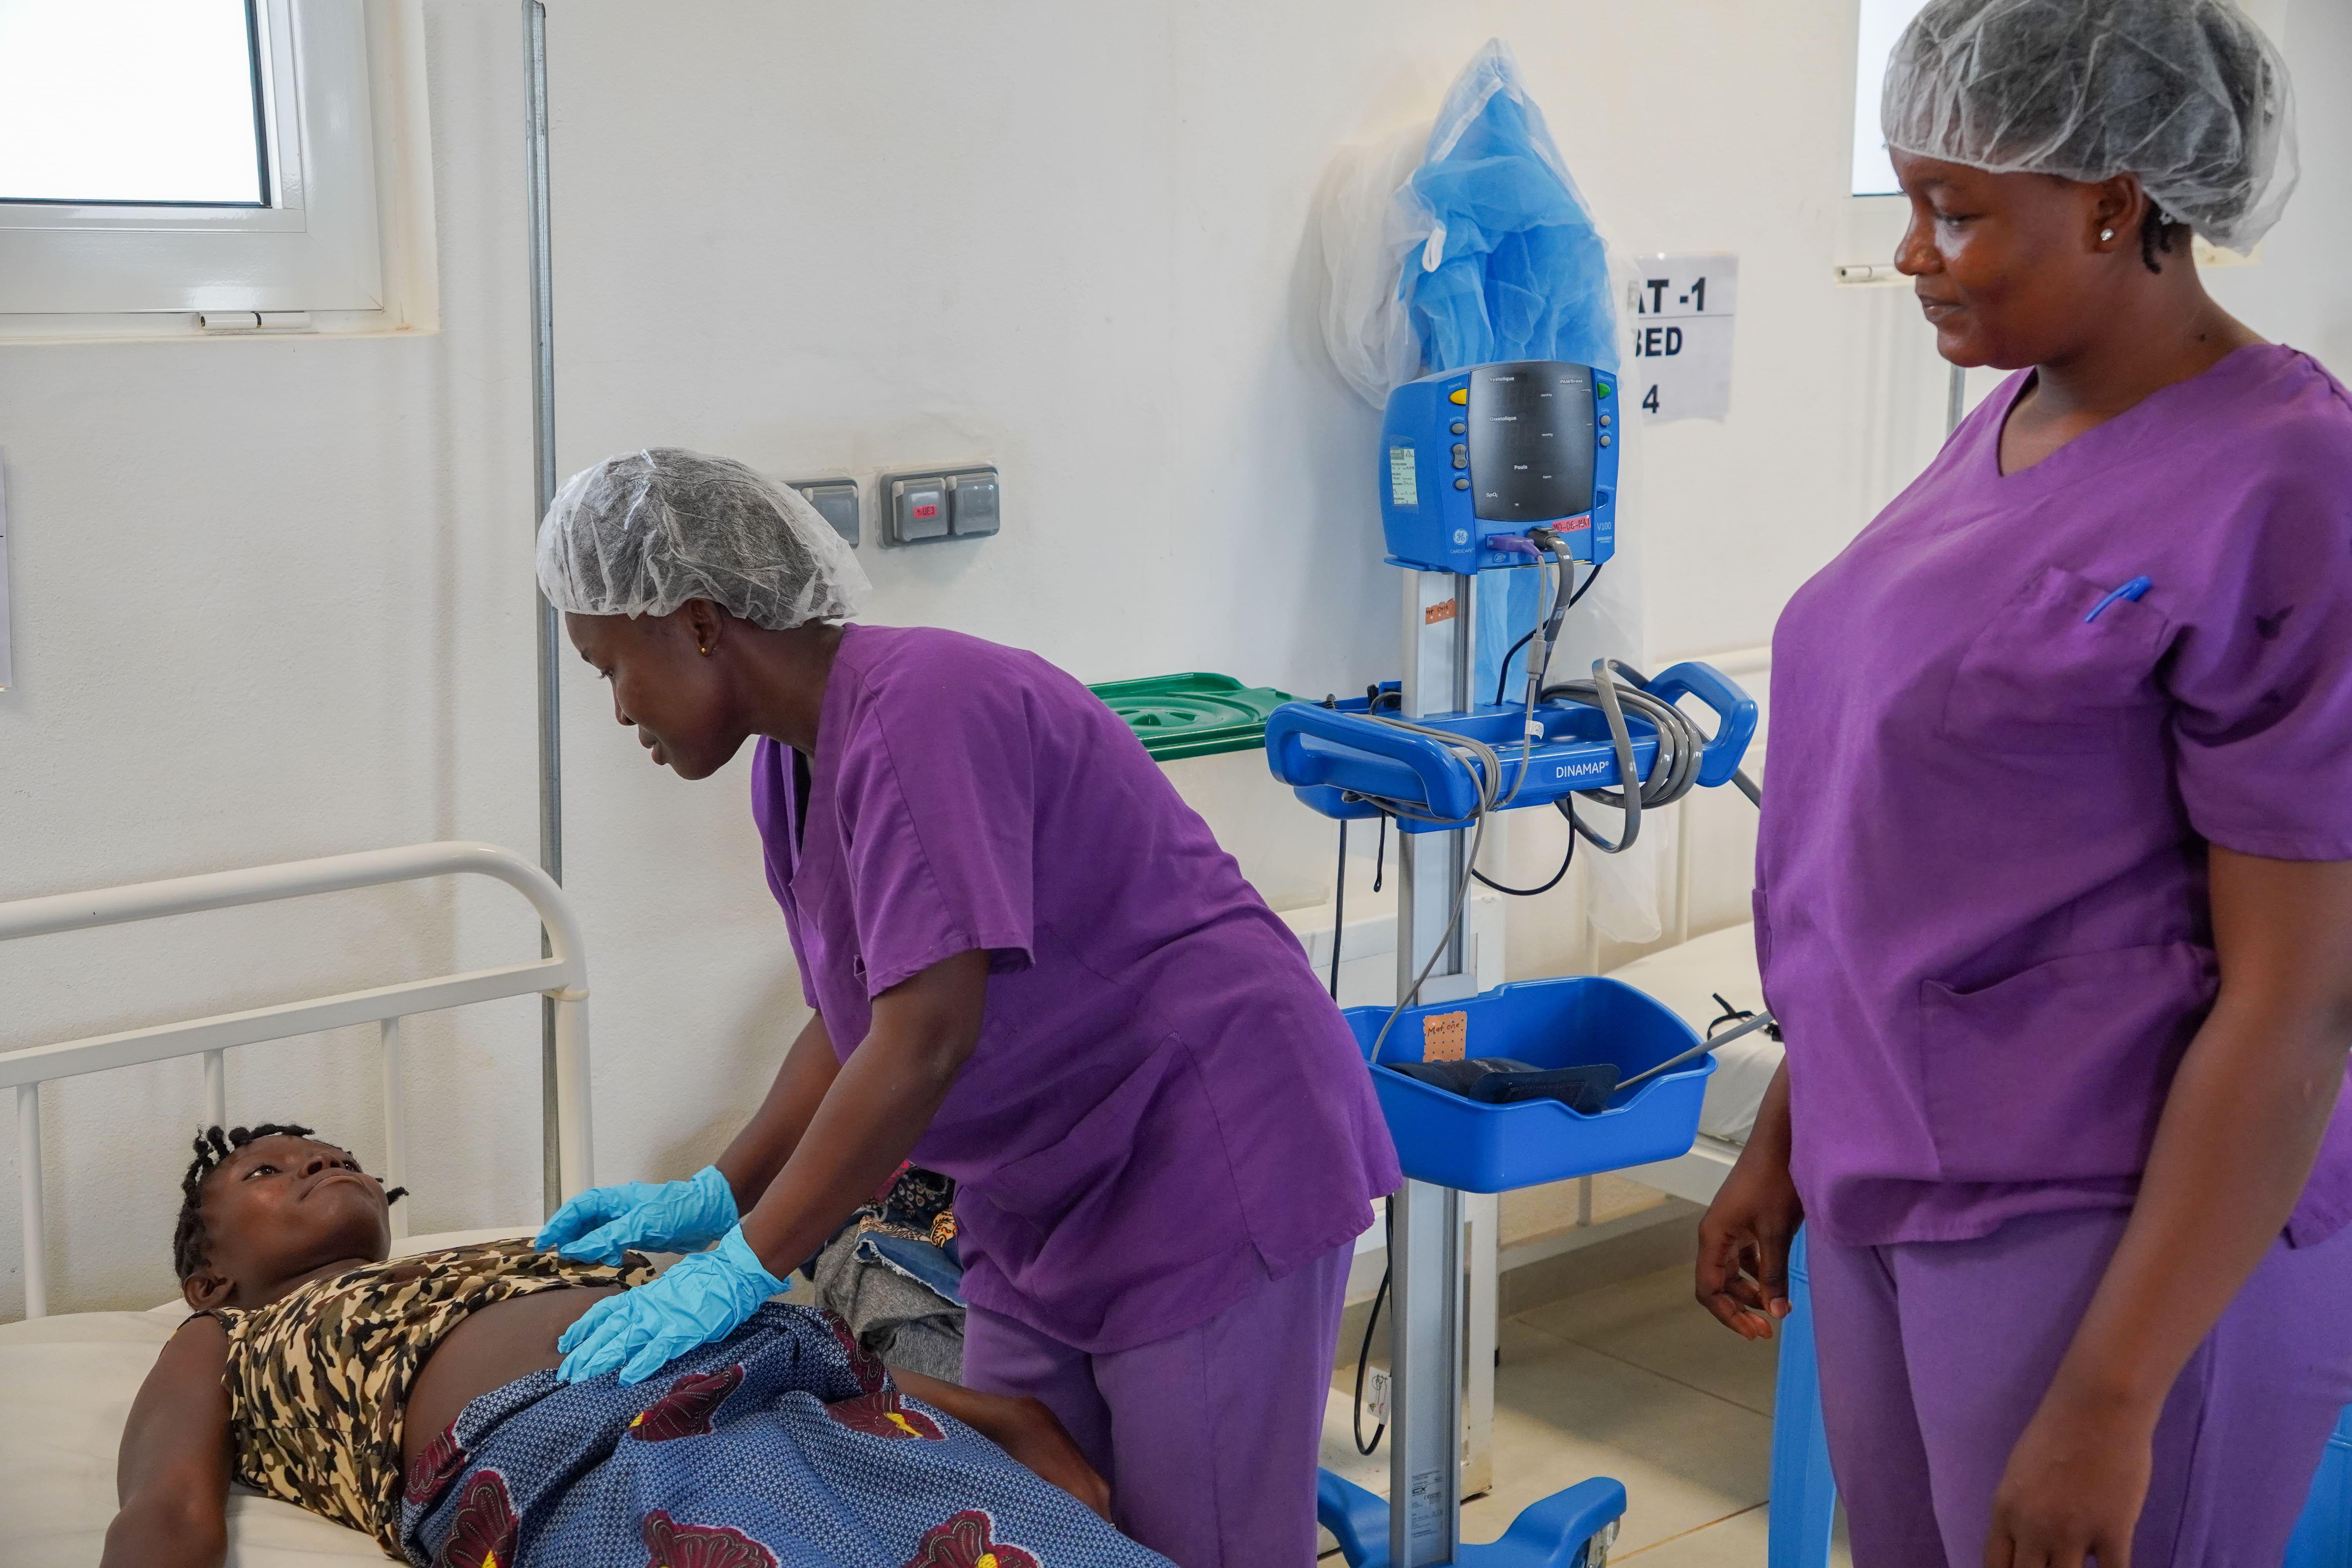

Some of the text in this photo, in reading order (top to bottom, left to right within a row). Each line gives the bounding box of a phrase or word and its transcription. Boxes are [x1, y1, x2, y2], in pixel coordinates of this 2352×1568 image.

[1642, 384, 1660, 414] 4
[1597, 522, 1612, 531] V100
[1427, 1025, 1443, 1037] Mat
